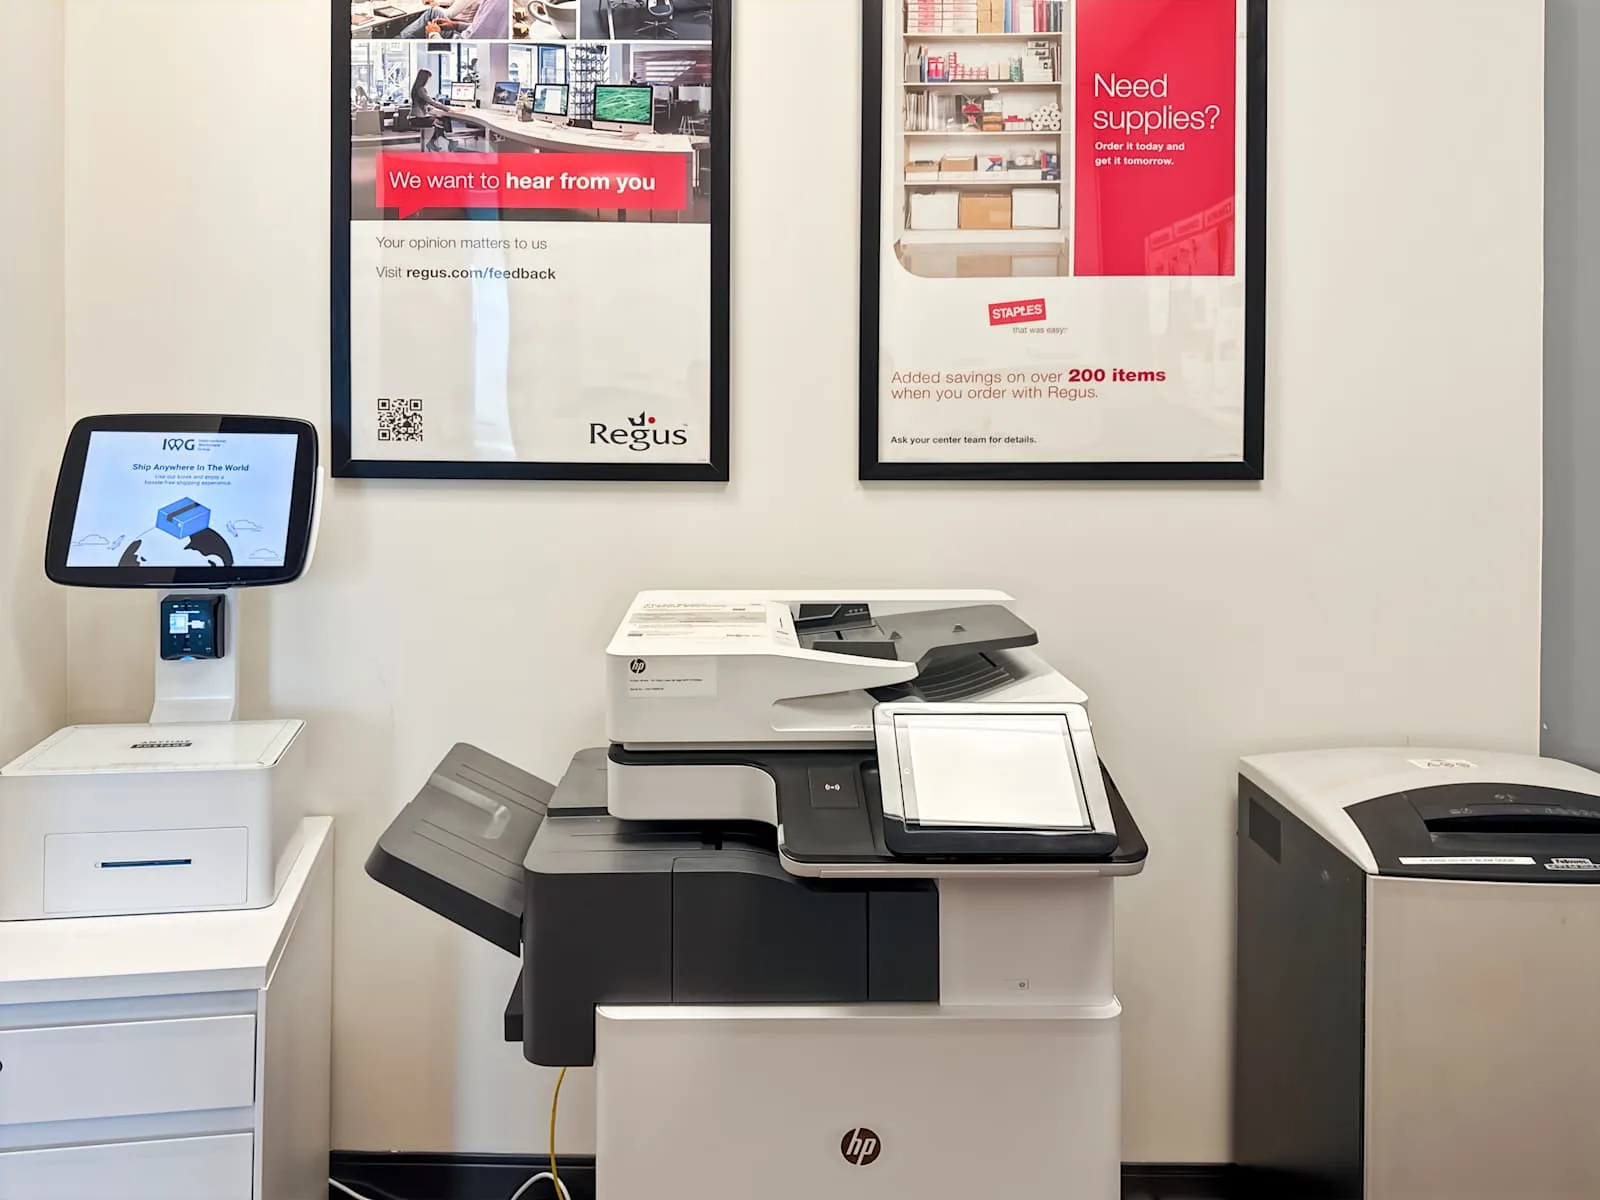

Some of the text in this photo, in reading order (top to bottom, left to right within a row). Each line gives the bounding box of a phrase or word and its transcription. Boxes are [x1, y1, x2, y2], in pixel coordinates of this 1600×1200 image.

[1094, 73, 1168, 98] Need
[1093, 104, 1220, 135] supplies?
[1094, 141, 1184, 152] Order it today and
[1094, 156, 1174, 167] get it tomorrow.
[388, 171, 656, 195] We want to hear from you
[376, 237, 547, 251] Your opinion matters to us
[376, 266, 556, 282] Visit regus.com/feedback
[992, 304, 1043, 319] STAPLES
[892, 368, 1166, 388] Added savings on over 200 items
[891, 385, 1098, 402] when you order with Regus.
[162, 439, 195, 451] IWG
[590, 423, 687, 451] Regus
[132, 464, 151, 472] Ship
[153, 464, 195, 472] Anywhere
[630, 659, 646, 674] hp
[843, 1128, 880, 1166] hp
